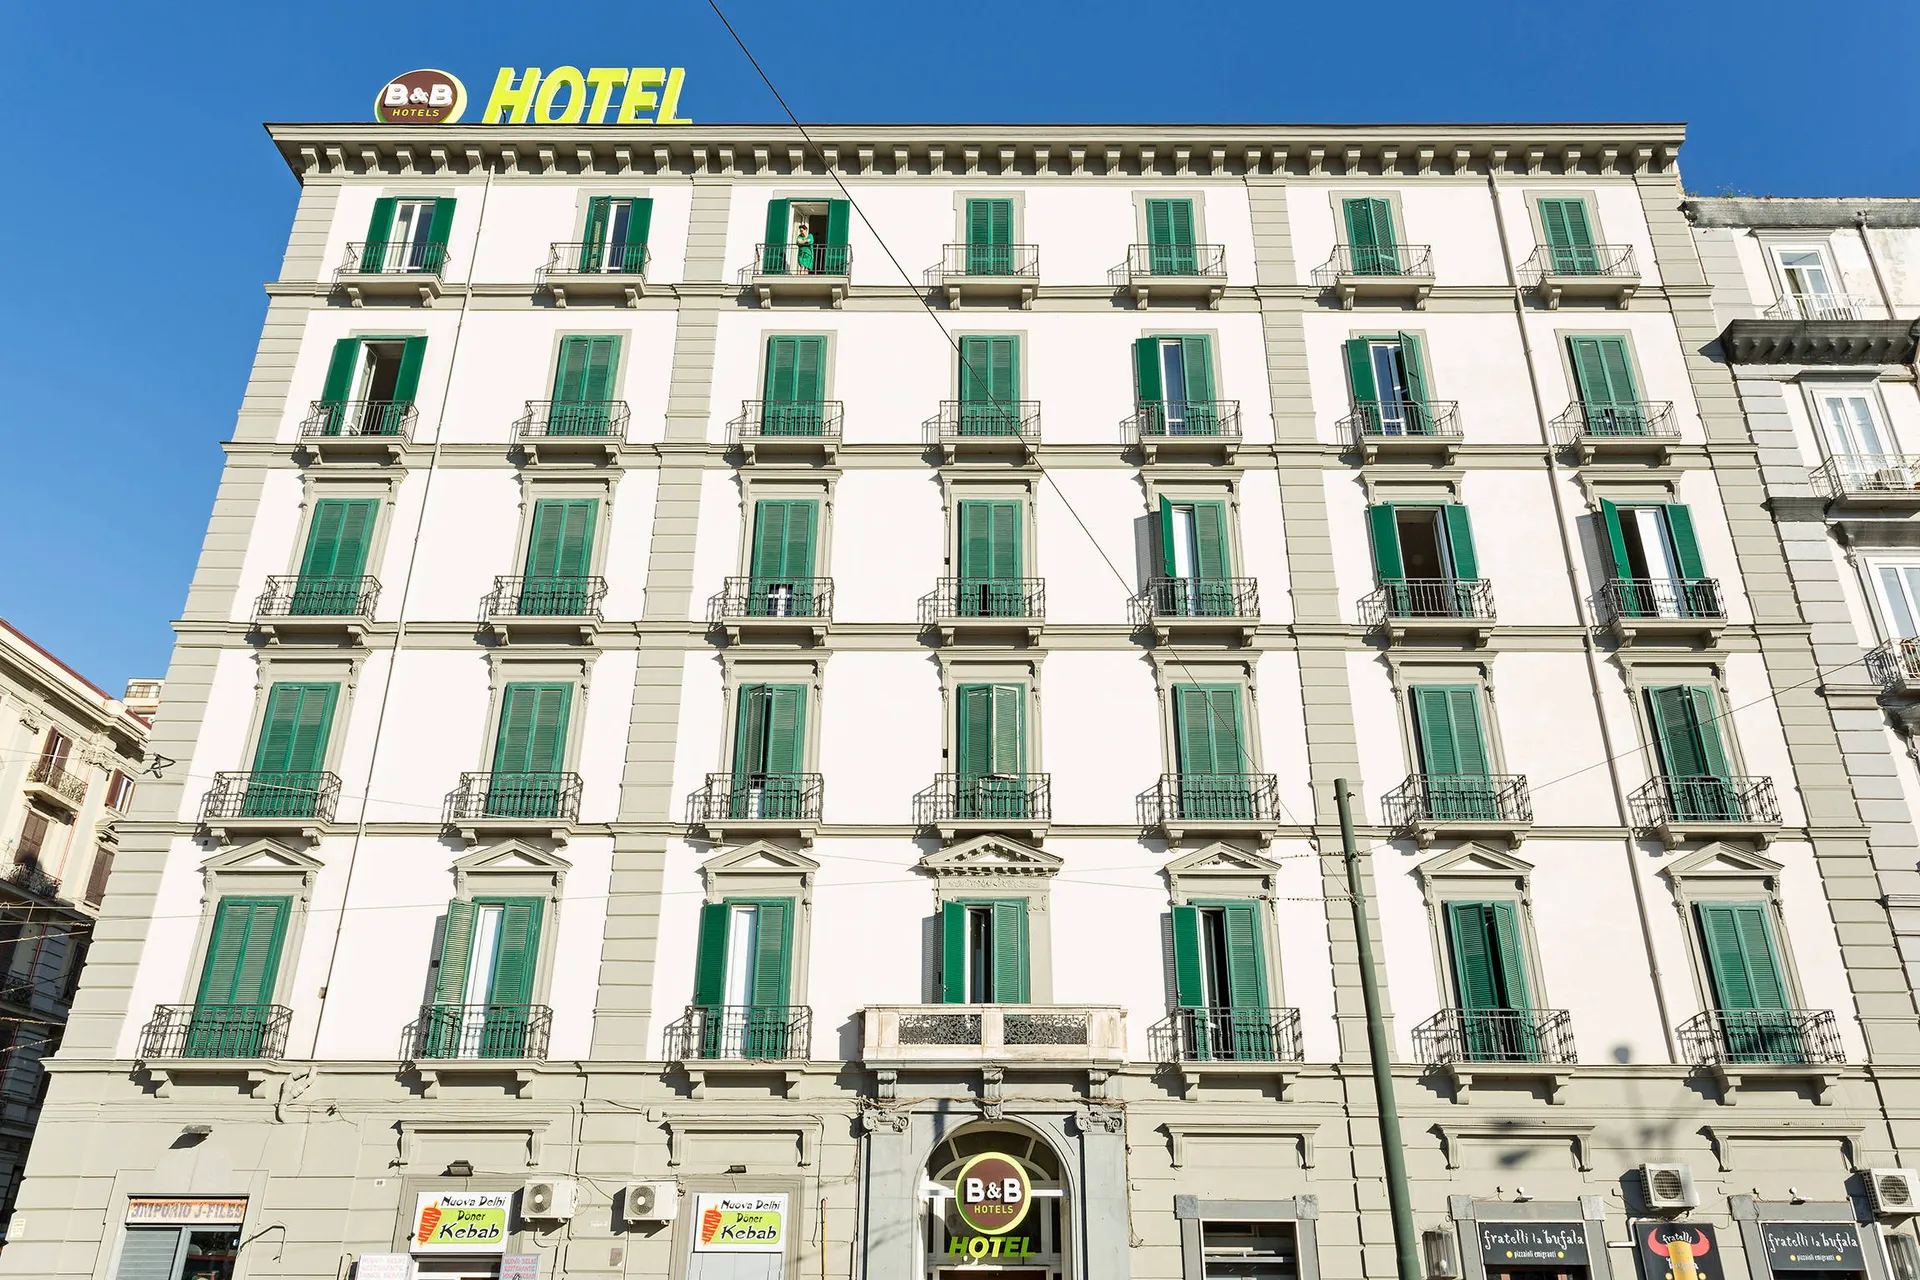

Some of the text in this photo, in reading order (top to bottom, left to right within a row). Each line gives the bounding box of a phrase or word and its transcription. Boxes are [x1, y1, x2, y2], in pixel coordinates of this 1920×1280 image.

[384, 84, 453, 107] B&B
[482, 65, 693, 124] HOTEL
[966, 1178, 1022, 1202] B&B
[441, 1196, 507, 1208] Nuova Delhi
[721, 1200, 781, 1211] Nuova Delhi
[974, 1205, 1014, 1214] HOTELS
[439, 1222, 500, 1239] Kebab
[720, 1224, 777, 1240] Kebab
[1484, 1229, 1584, 1250] fratelli la bufala
[948, 1236, 1035, 1258] HOTEL
[1768, 1232, 1858, 1253] fratelli la bufala
